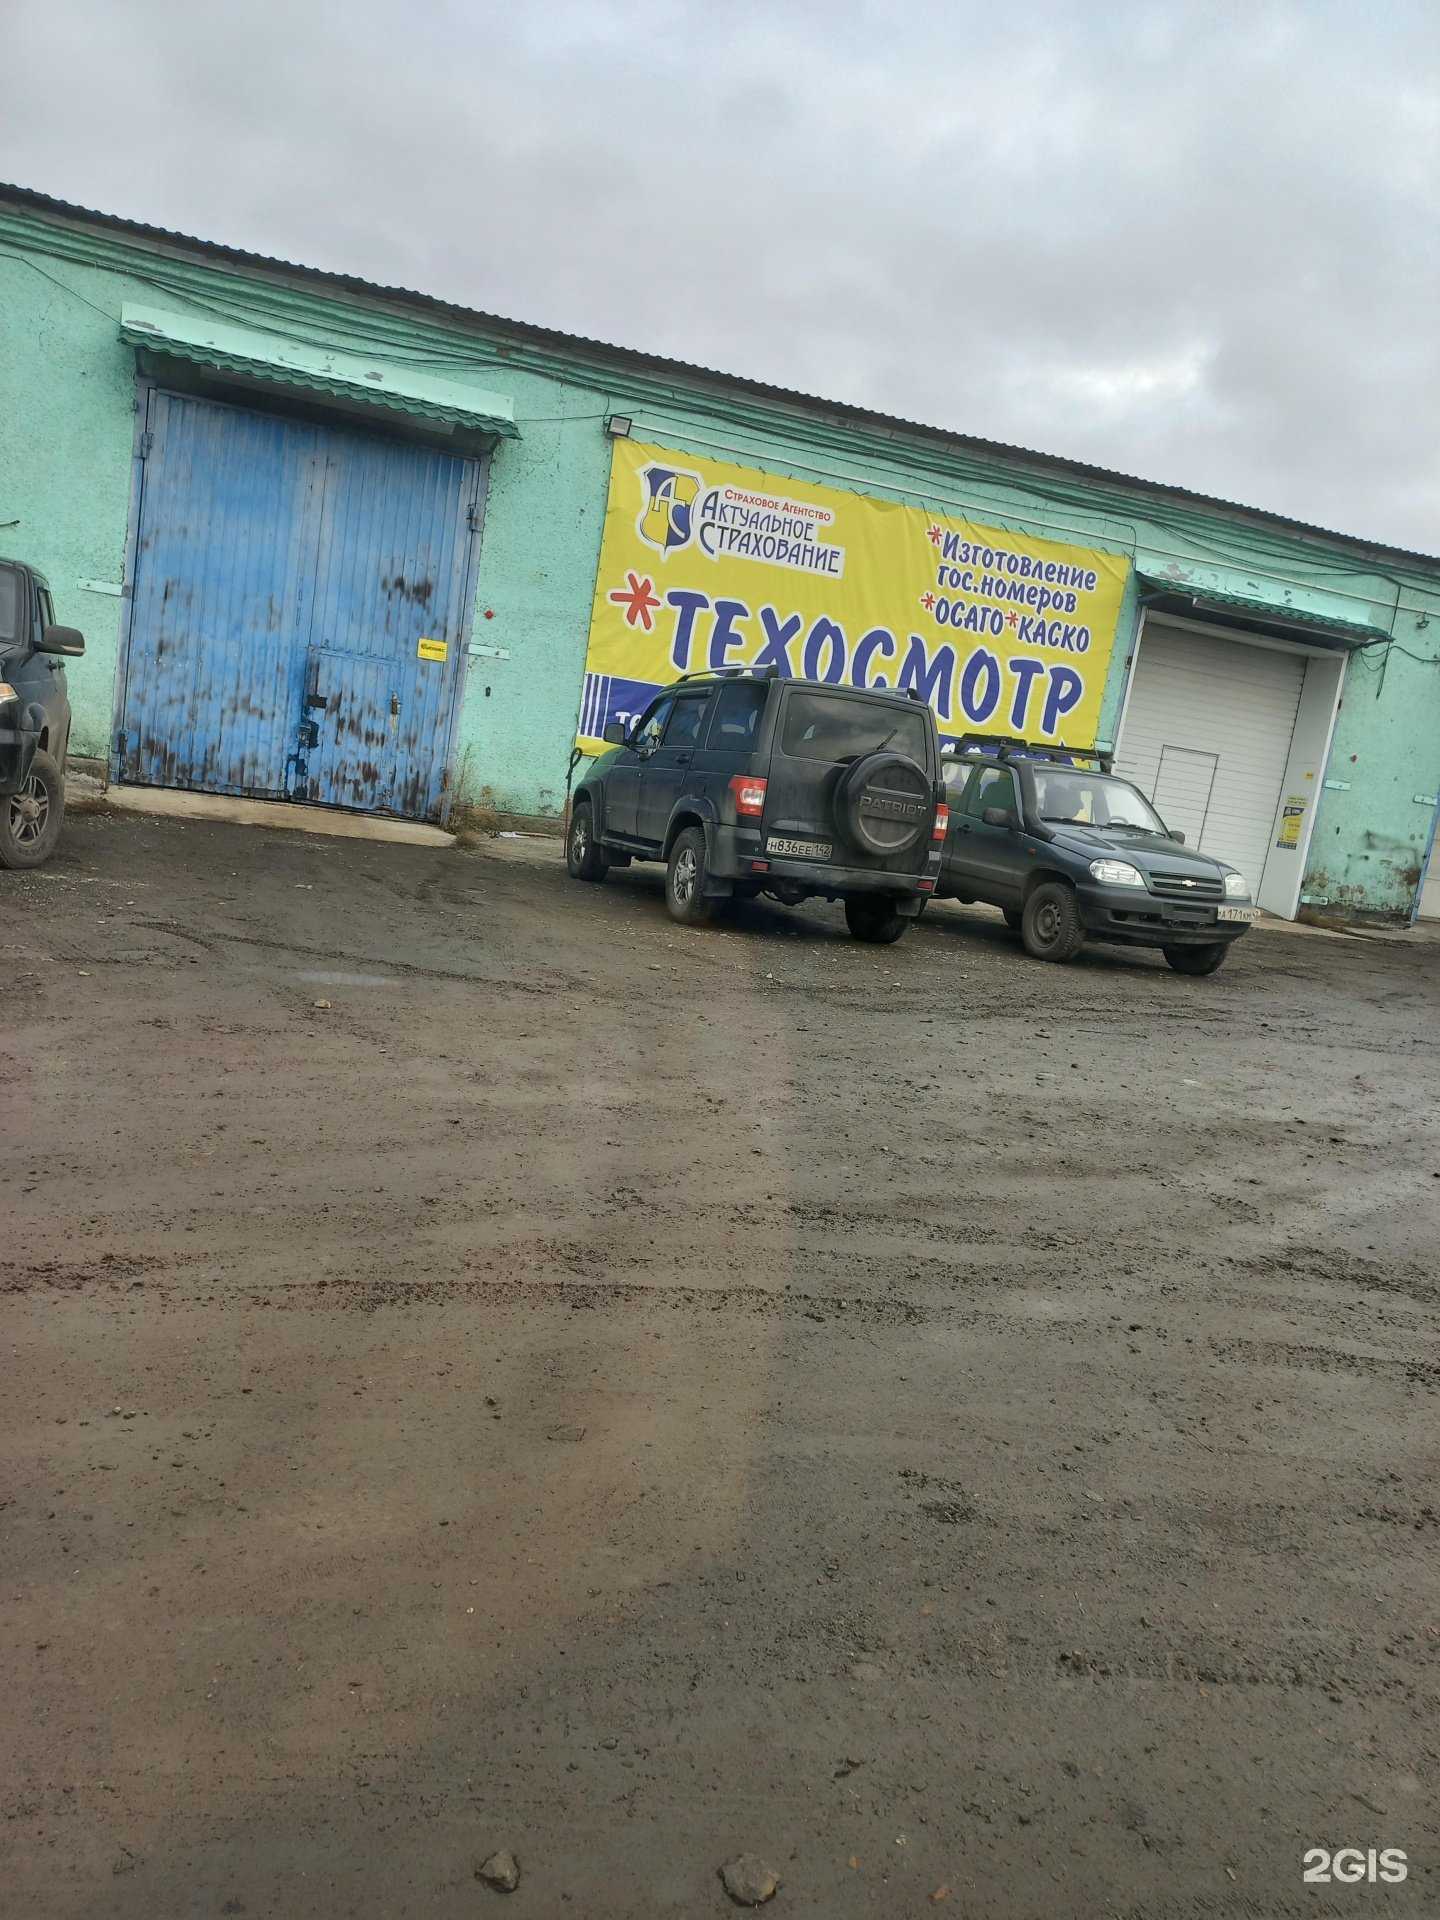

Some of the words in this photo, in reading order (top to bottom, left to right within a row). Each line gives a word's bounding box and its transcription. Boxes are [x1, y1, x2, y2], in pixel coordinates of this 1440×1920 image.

[942, 530, 1097, 591] Изготовление
[667, 591, 1082, 734] ТЕХОСМОТР
[859, 795, 927, 818] PATRIOT
